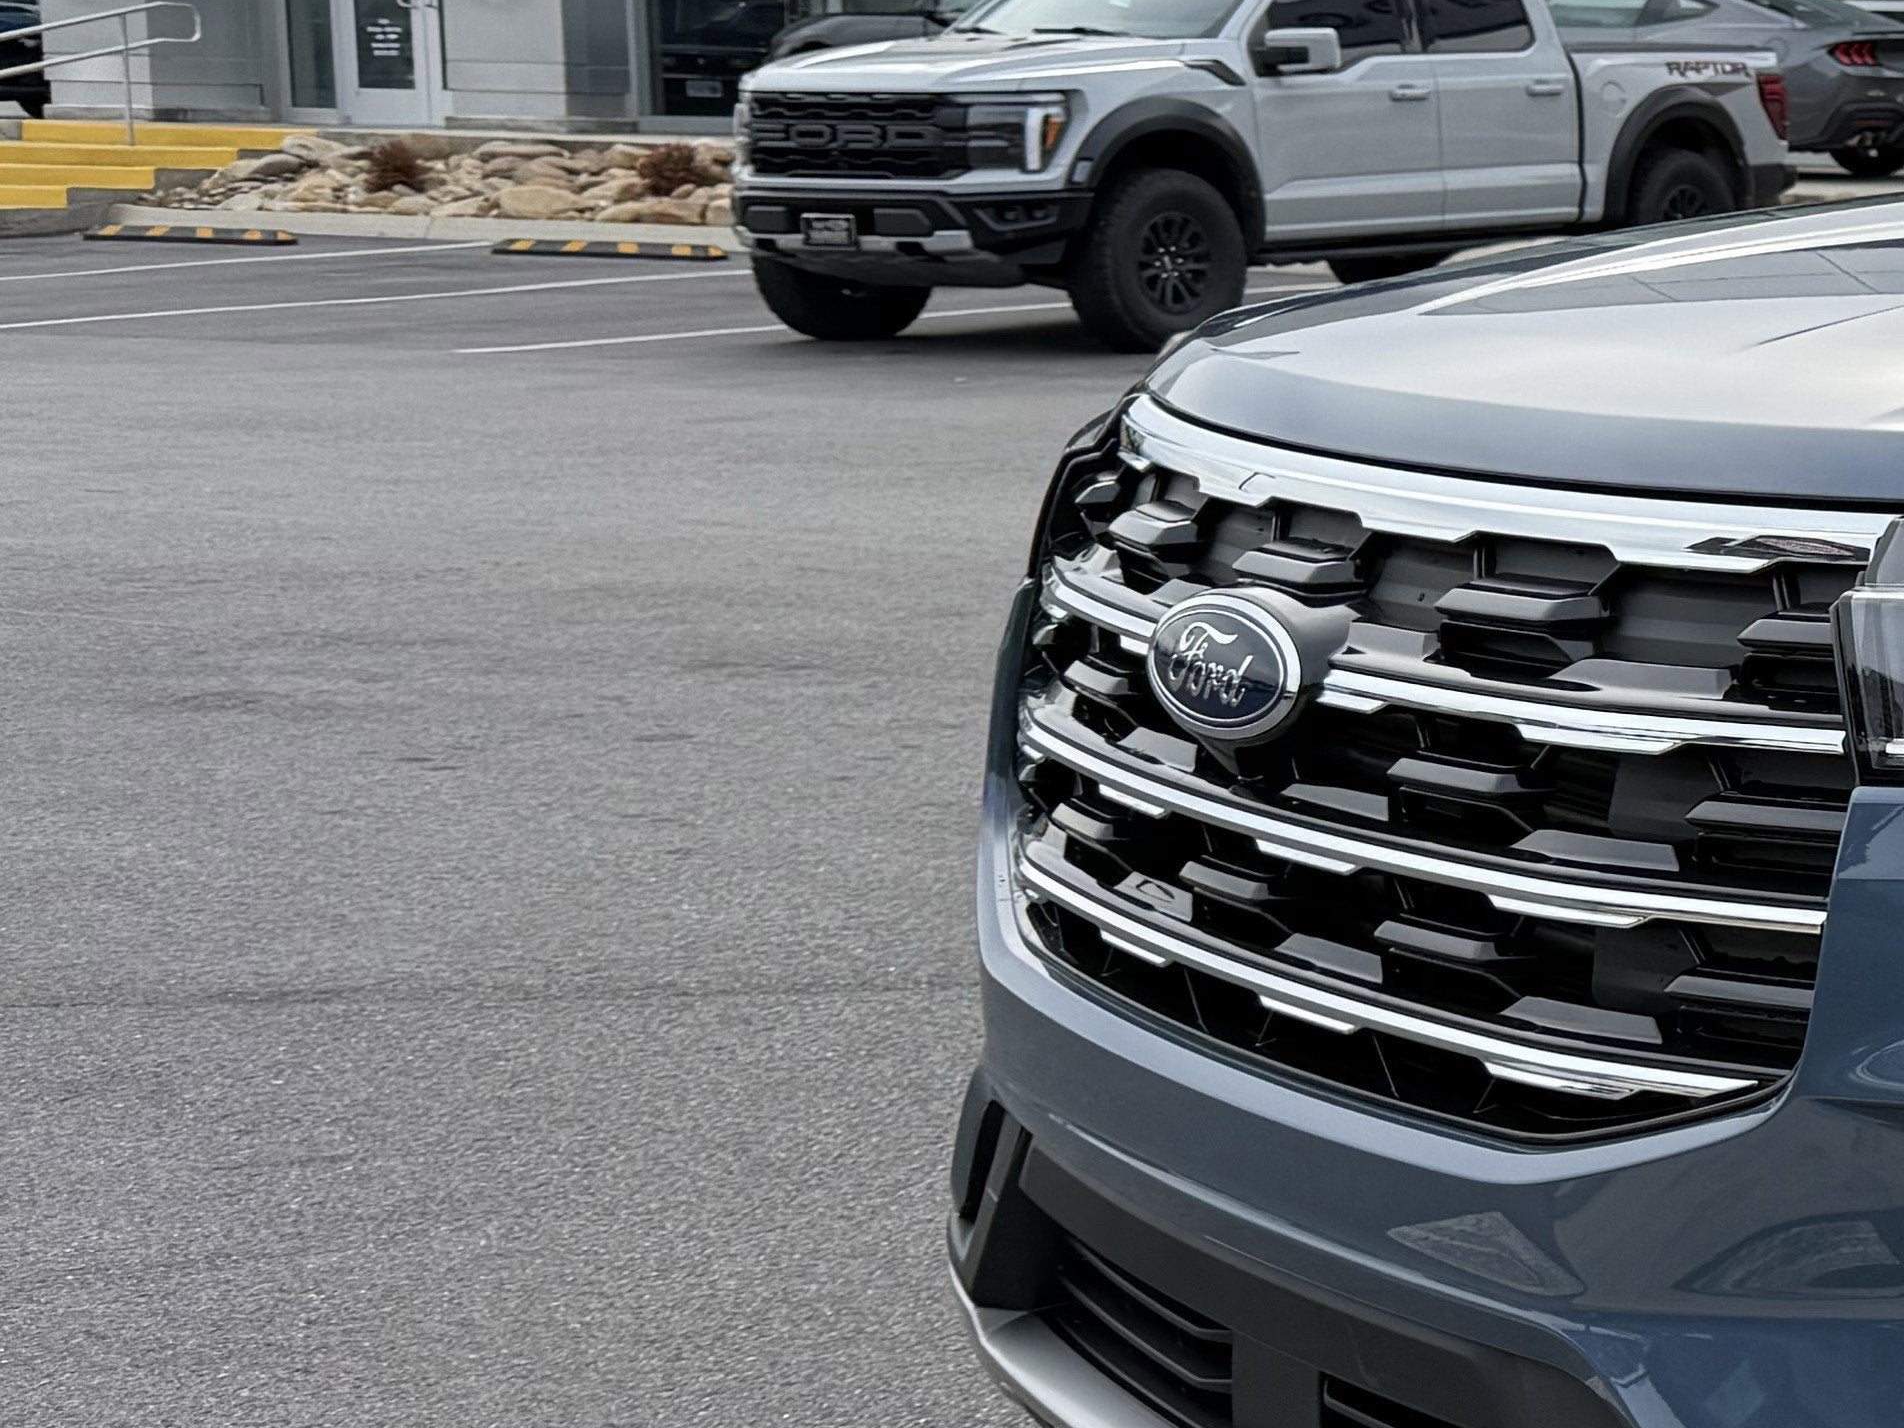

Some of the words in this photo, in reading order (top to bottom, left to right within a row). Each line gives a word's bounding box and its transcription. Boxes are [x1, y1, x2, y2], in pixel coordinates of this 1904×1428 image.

[1665, 60, 1752, 78] RAPTOR
[751, 123, 945, 149] FORD
[1170, 621, 1254, 707] Ford
